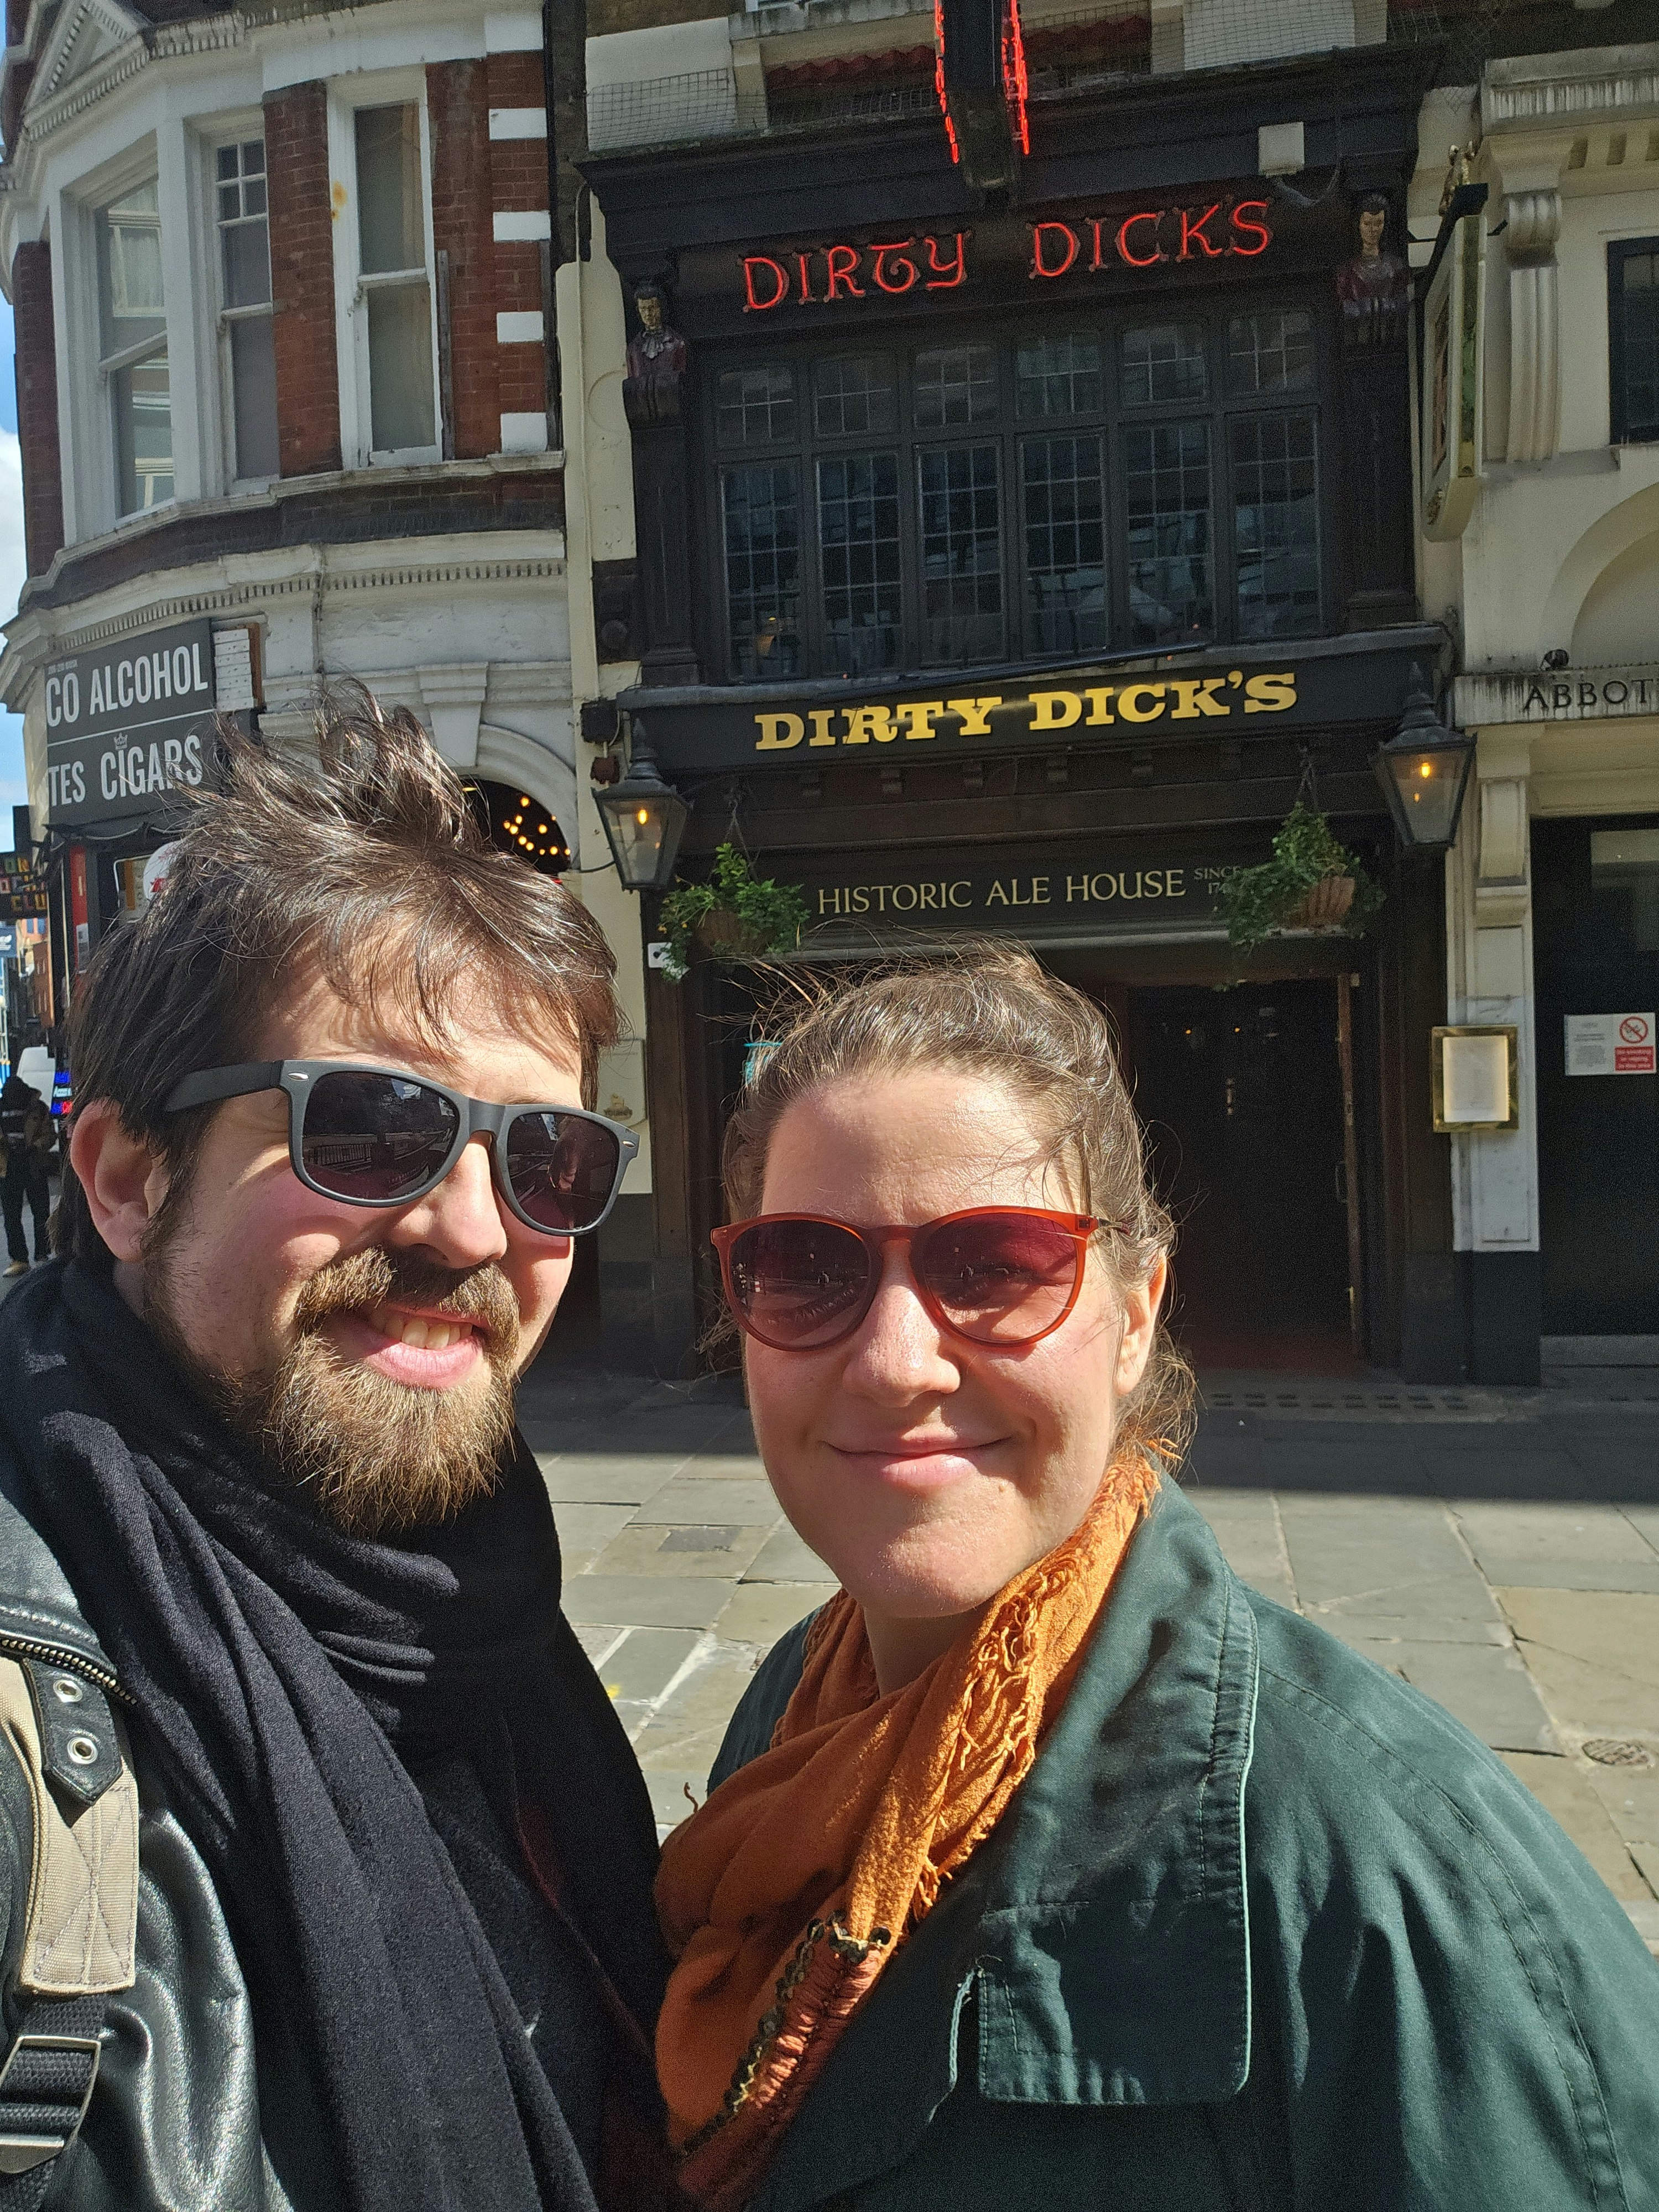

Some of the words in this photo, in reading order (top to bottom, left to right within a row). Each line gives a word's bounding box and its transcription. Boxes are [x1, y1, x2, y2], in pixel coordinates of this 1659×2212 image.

[737, 230, 972, 313] DIRTY
[1026, 195, 1273, 279] DICKS
[90, 643, 208, 715] ALCOHOL
[754, 696, 1002, 750] DIRTY
[1028, 670, 1297, 731] DICK'S
[1523, 678, 1657, 710] ABBOT
[101, 735, 202, 801] CIGARS
[818, 881, 973, 915] HISTORIC
[985, 877, 1051, 906] ALE
[1066, 869, 1187, 902] HOUSE
